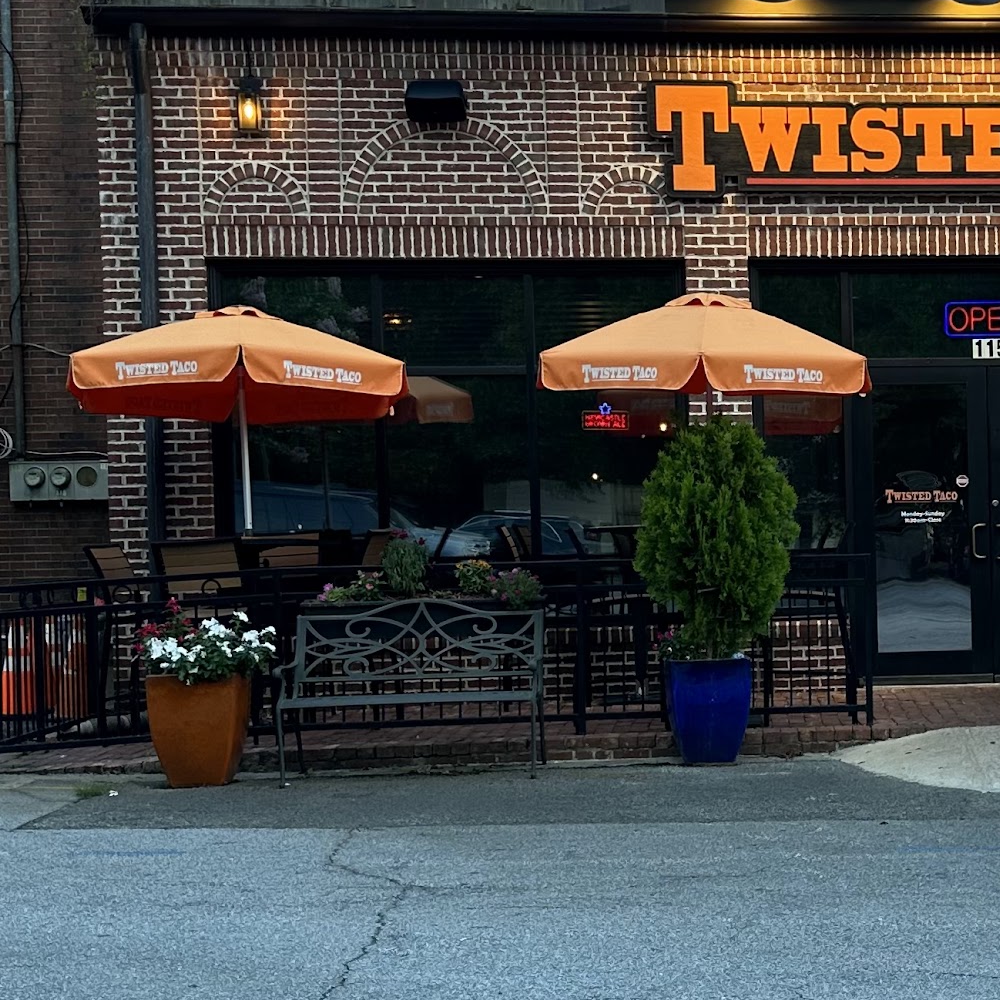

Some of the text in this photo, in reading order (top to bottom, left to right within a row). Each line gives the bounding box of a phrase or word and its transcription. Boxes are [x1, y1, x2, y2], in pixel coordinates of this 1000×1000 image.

[115, 360, 198, 380] TWISTED TACO
[283, 360, 362, 384] TWISTED TACO
[582, 364, 658, 383] TWISTED TACO
[744, 364, 823, 383] TWISTED TACO
[885, 489, 958, 504] TWISTED TACO
